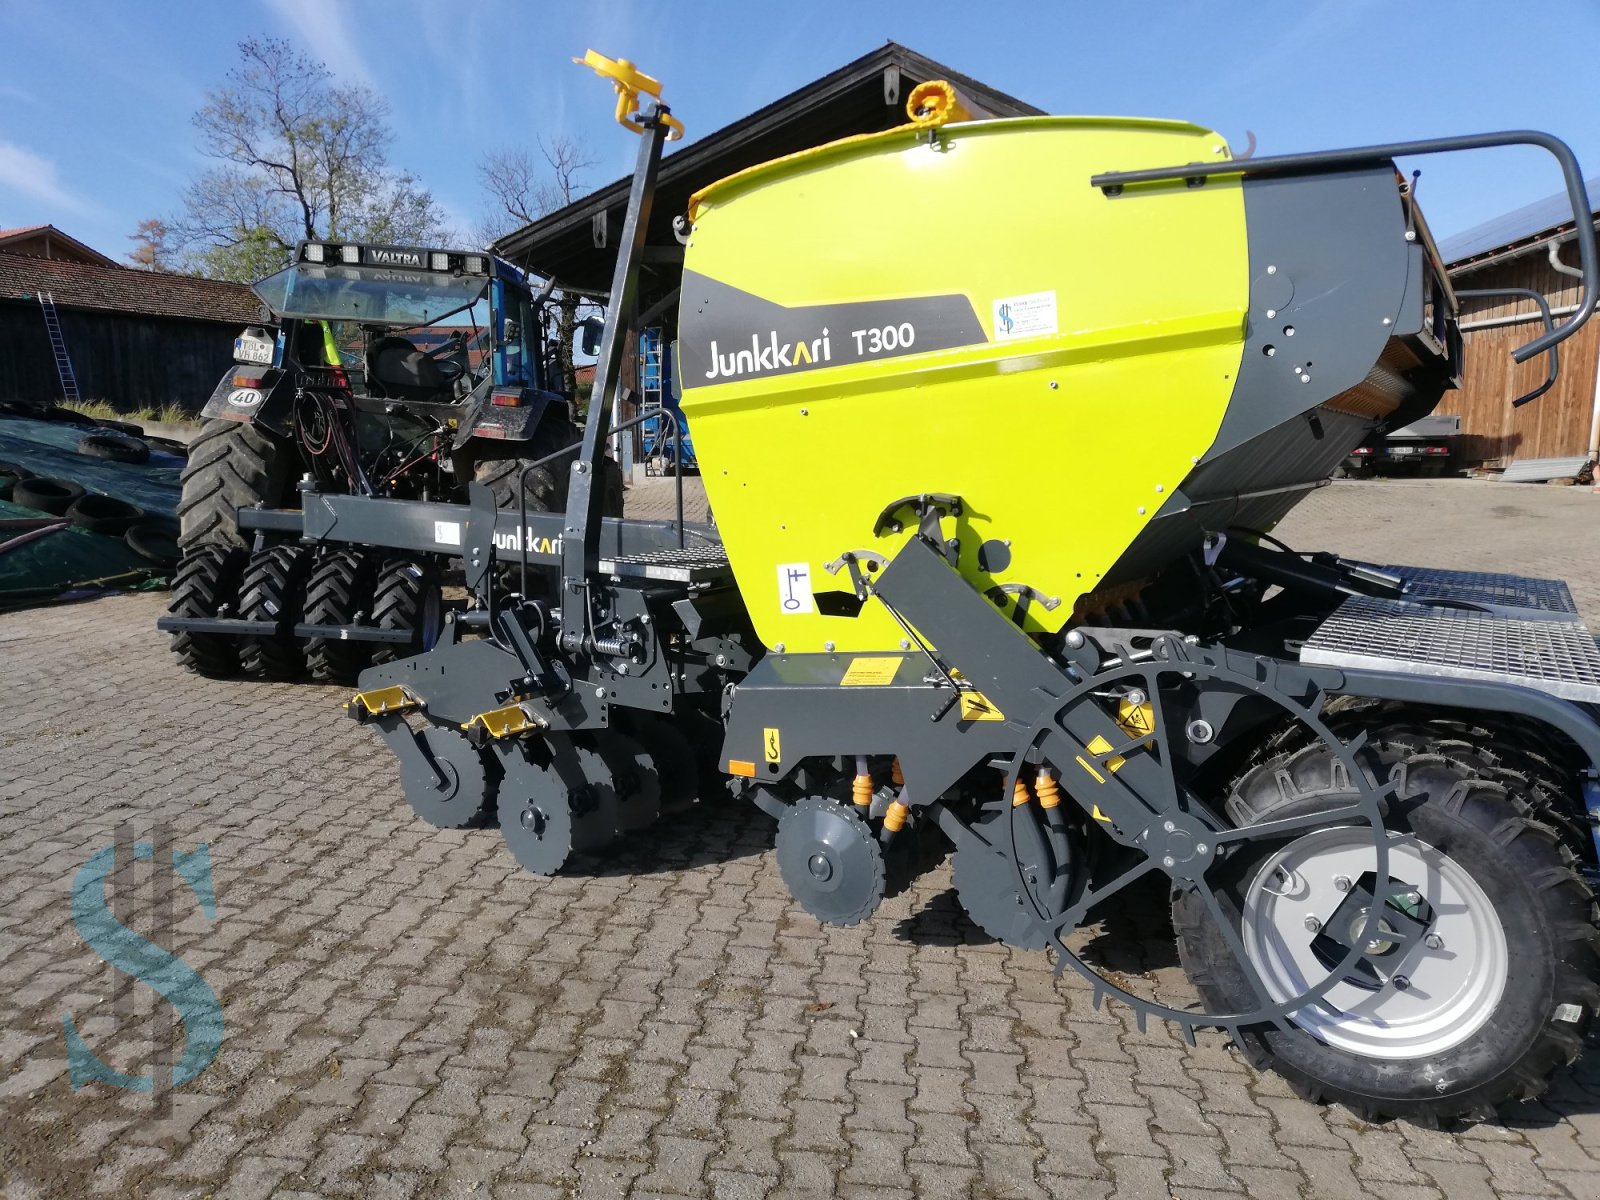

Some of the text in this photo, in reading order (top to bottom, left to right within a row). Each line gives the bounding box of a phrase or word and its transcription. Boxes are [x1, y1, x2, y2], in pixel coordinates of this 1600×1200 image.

[371, 250, 420, 265] VALTRA
[851, 323, 915, 356] T300
[252, 352, 269, 363] 862
[232, 390, 254, 404] 40
